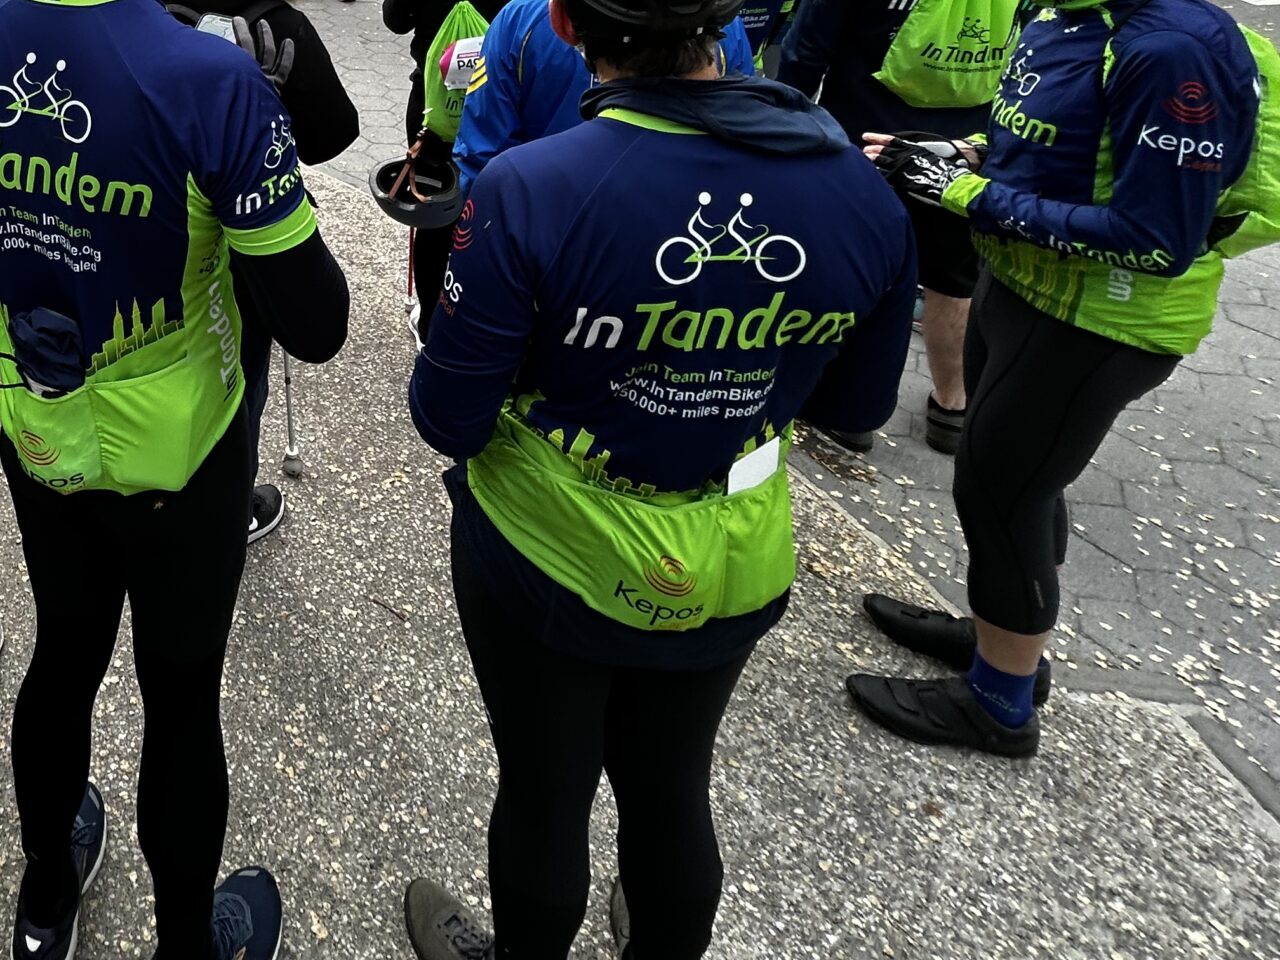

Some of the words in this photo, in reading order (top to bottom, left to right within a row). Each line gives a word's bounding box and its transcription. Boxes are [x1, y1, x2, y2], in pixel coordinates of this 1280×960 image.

[921, 42, 1007, 64] InTndm
[1136, 124, 1224, 169] Kepos
[8, 205, 39, 225] Team
[563, 291, 856, 353] InTandem
[625, 362, 659, 378] Join
[663, 365, 706, 383] Team
[682, 405, 720, 419] miles
[613, 579, 705, 626] Kepos
